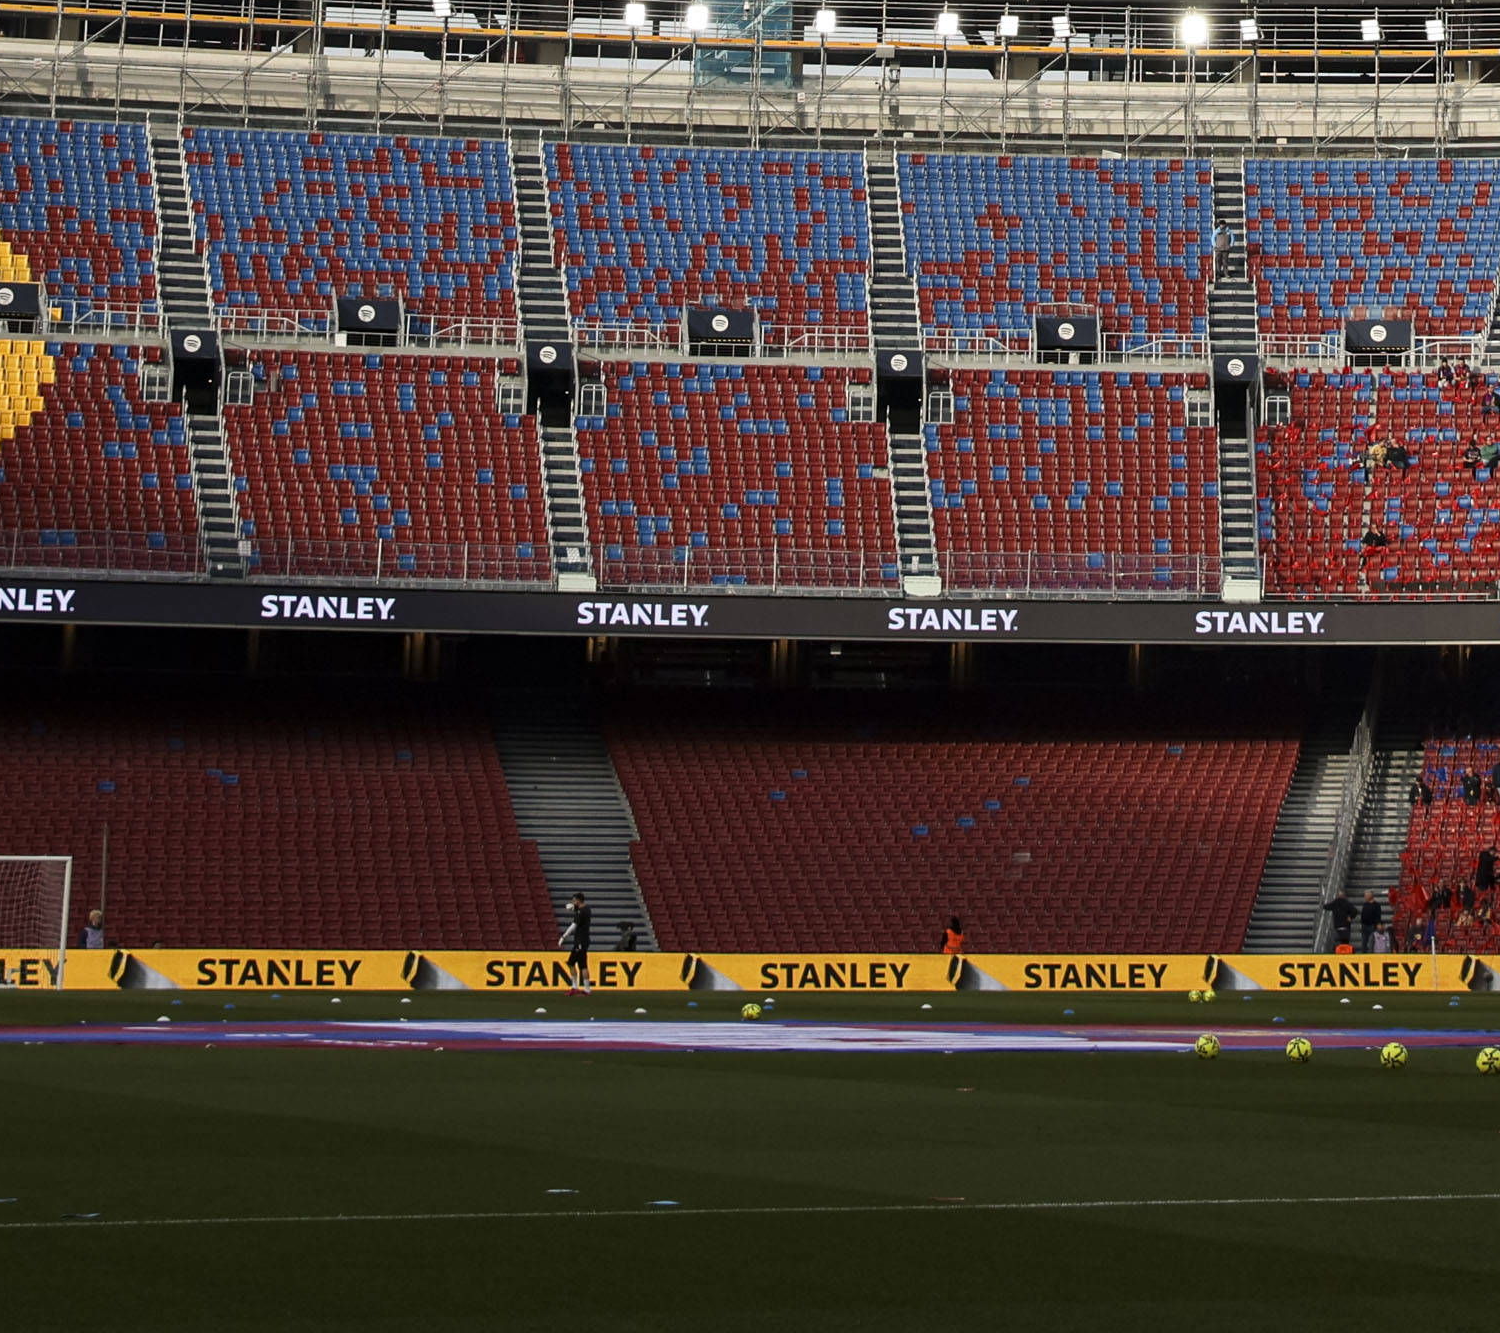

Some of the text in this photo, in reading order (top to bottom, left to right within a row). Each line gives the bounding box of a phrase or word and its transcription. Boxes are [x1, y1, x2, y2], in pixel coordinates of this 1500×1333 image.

[197, 958, 362, 986] STANLEY
[760, 963, 910, 989] STANLEY
[1024, 963, 1168, 989] STANLEY
[1279, 962, 1422, 988] STANLEY
